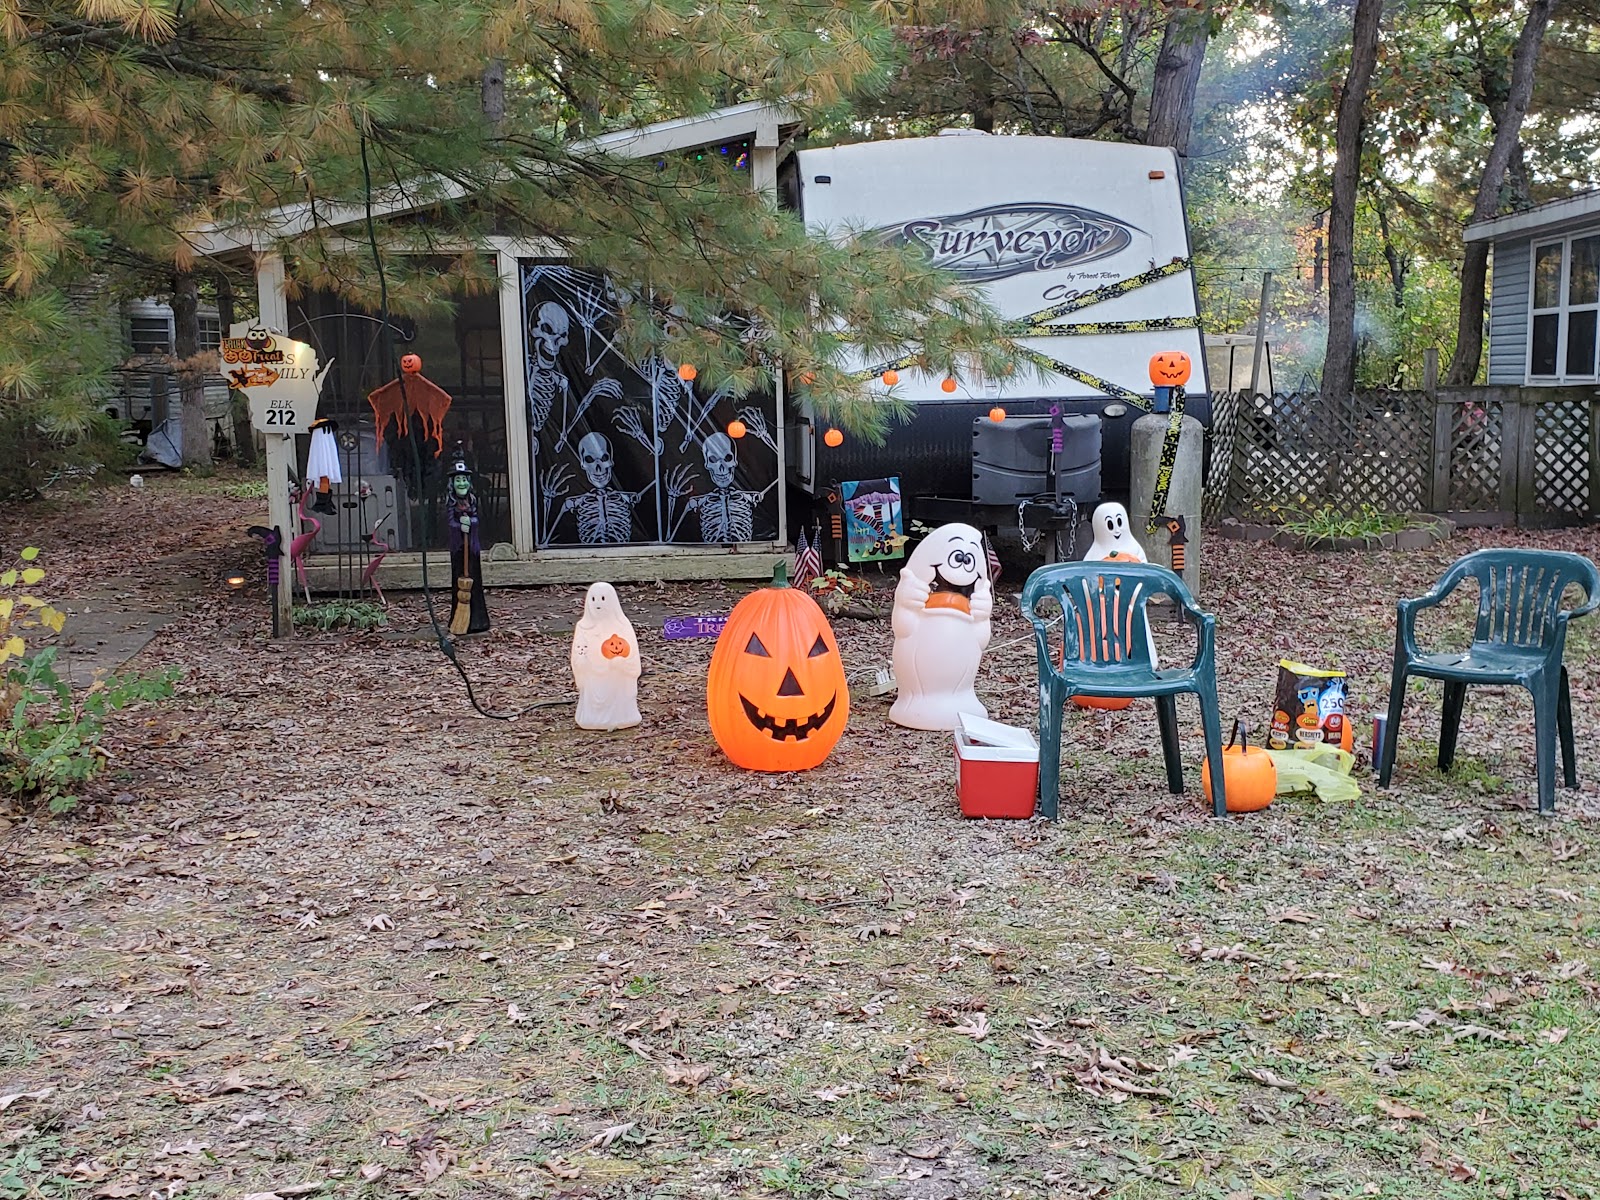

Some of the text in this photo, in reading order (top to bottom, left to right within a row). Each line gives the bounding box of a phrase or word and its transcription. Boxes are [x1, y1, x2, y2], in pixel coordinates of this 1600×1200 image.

[902, 220, 1111, 270] Surveyor
[1066, 271, 1121, 282] by Forest River
[1031, 262, 1185, 322] DANGER DANGER DANGER DANGER
[1075, 324, 1099, 334] DANGER
[1123, 321, 1147, 331] DANGER
[1171, 317, 1195, 328] DANGER
[252, 351, 281, 362] Treat
[254, 367, 310, 380] MILY
[1079, 373, 1101, 389] DANGER
[270, 399, 294, 409] ELK
[266, 409, 296, 426] 212
[1157, 411, 1183, 492] DANGER DANGER
